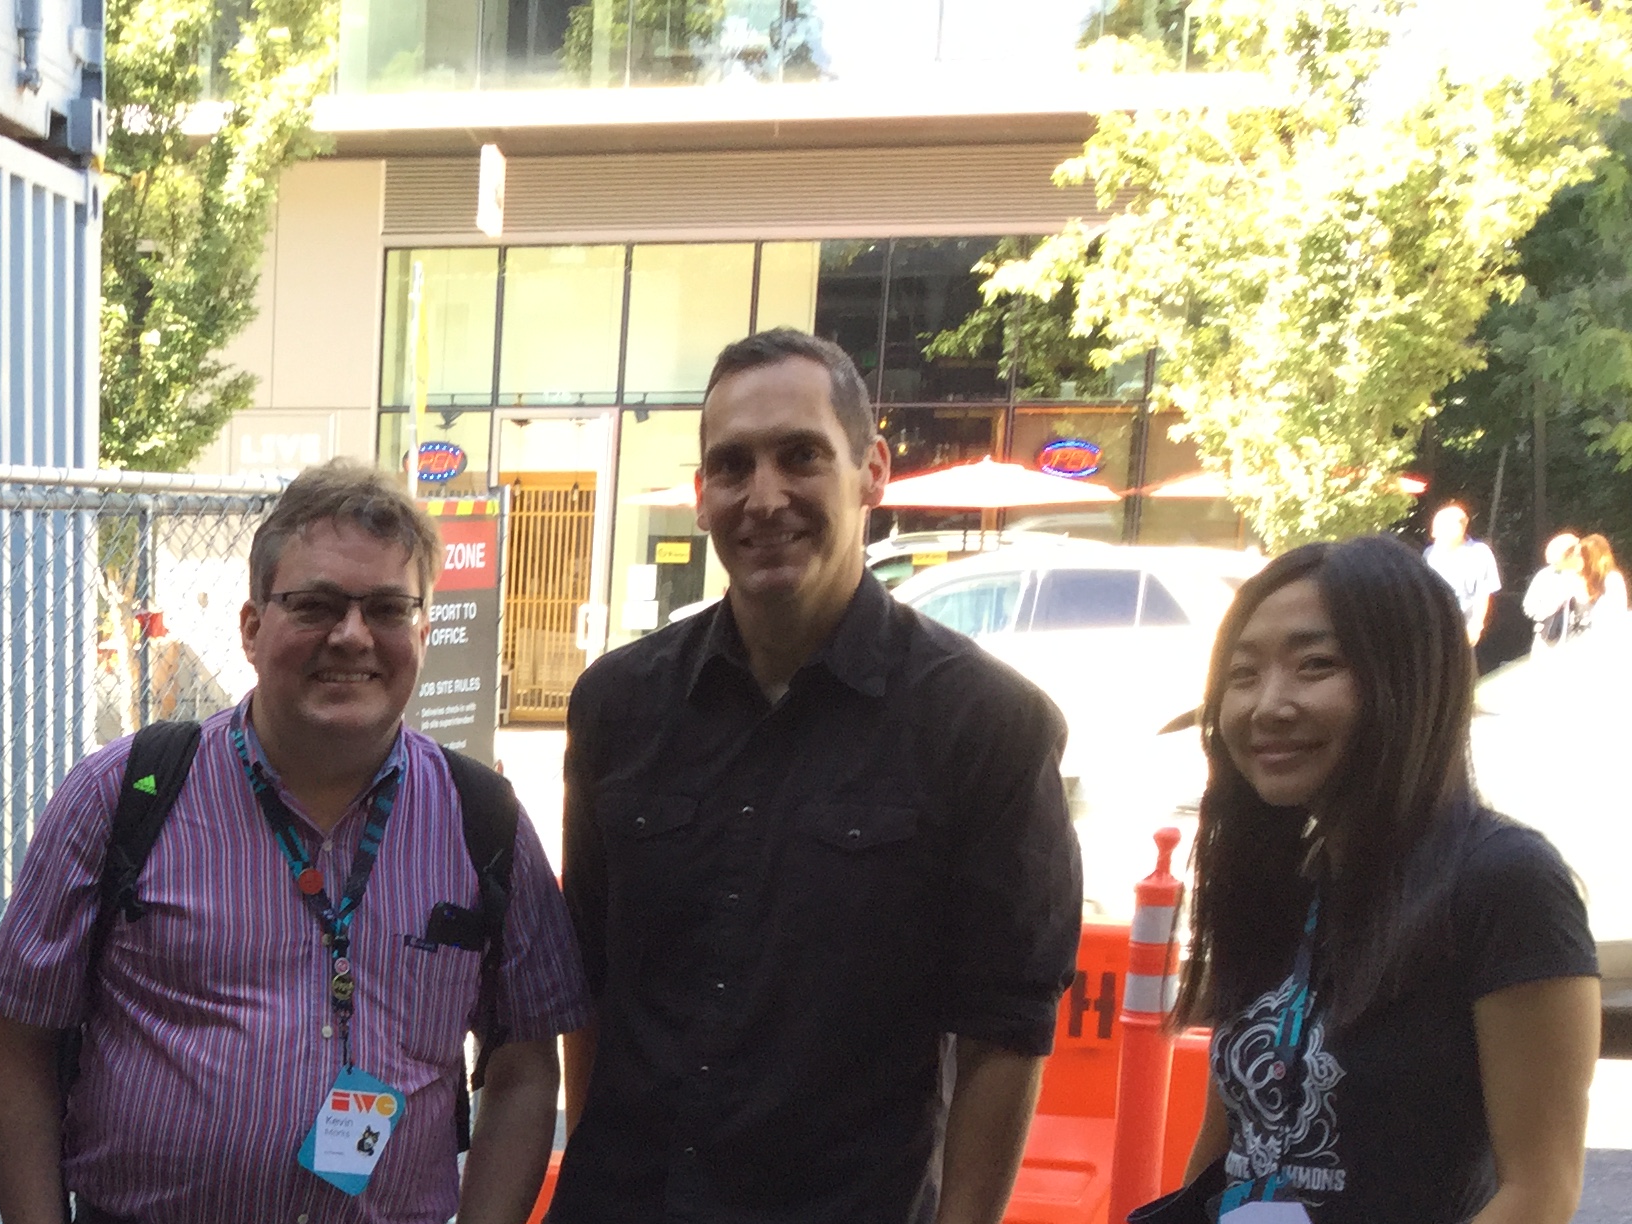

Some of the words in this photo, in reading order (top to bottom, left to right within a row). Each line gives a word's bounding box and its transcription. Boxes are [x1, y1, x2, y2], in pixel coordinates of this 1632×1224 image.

[240, 432, 321, 464] LIVE
[444, 542, 486, 570] ZONE
[429, 604, 462, 622] EPORT
[463, 602, 477, 620] TO
[419, 682, 436, 697] JOB
[436, 679, 453, 695] SITE
[454, 676, 481, 693] RULES
